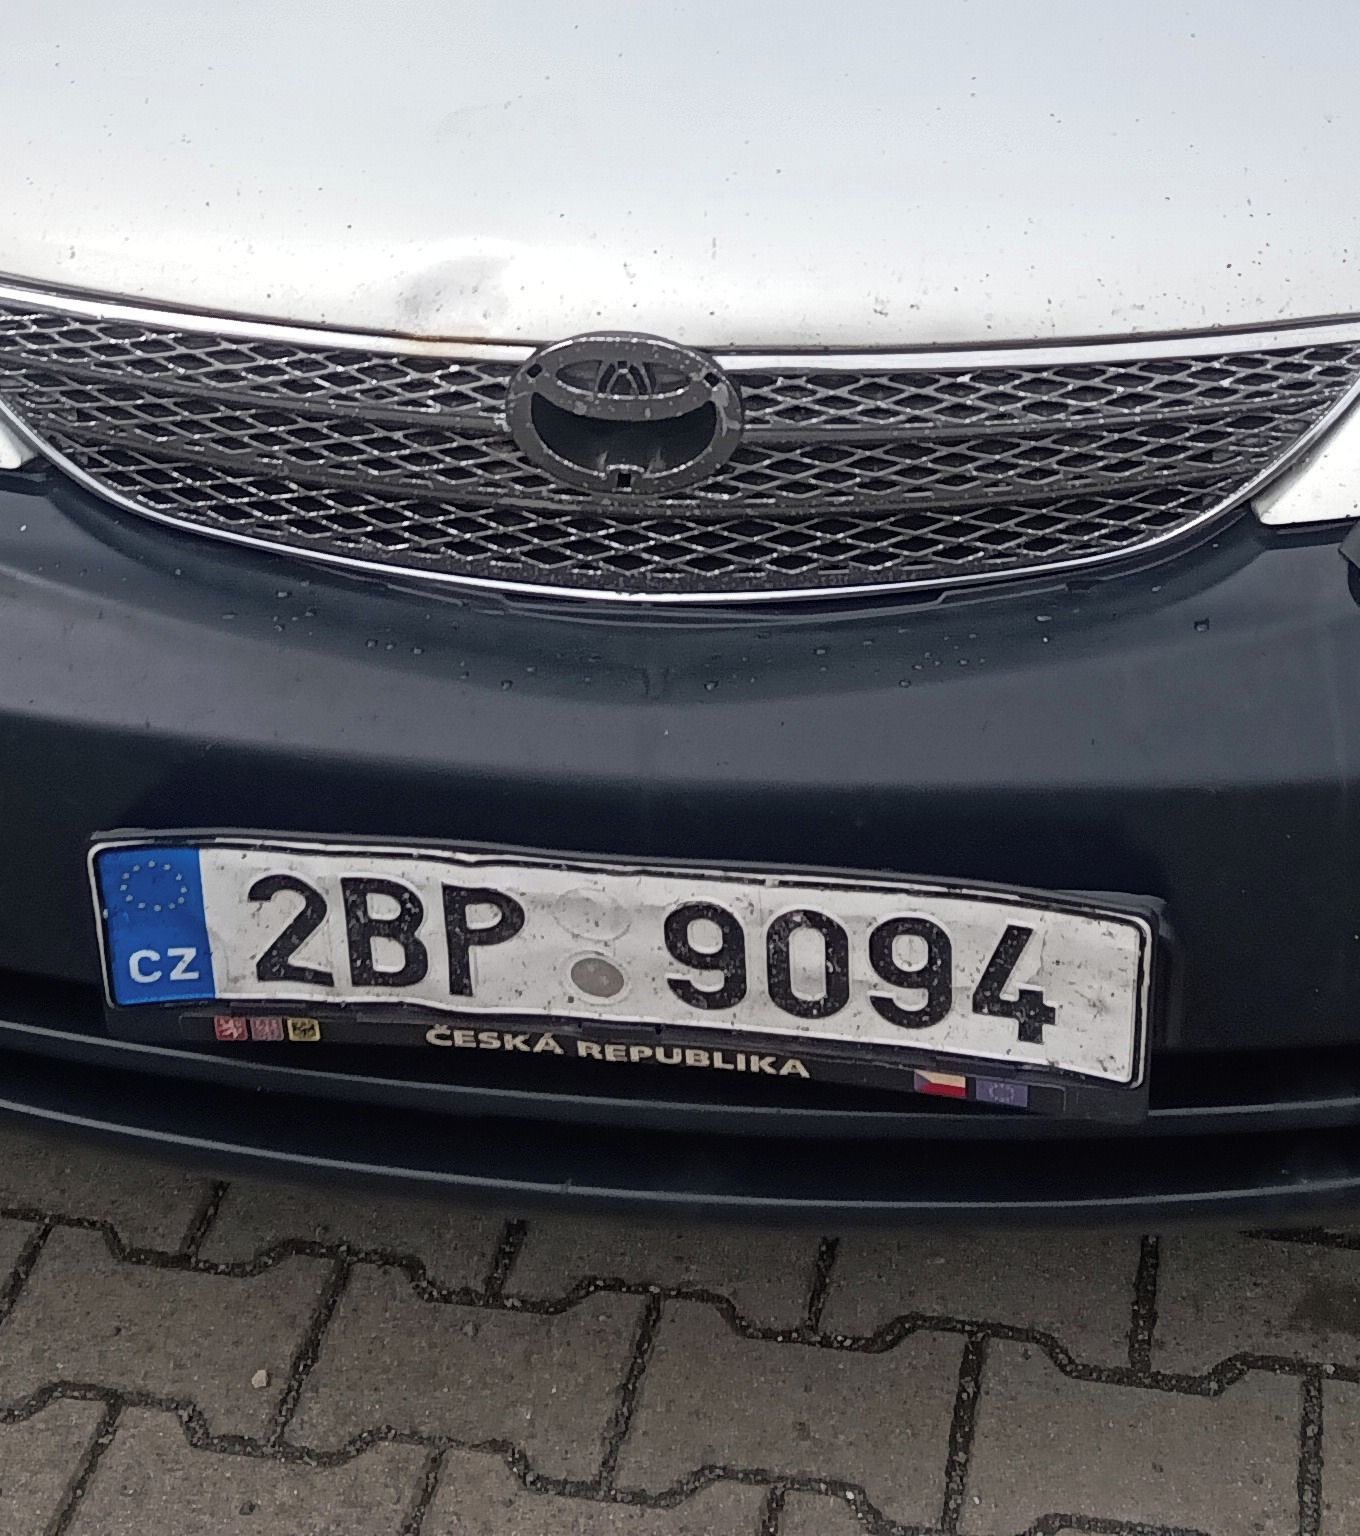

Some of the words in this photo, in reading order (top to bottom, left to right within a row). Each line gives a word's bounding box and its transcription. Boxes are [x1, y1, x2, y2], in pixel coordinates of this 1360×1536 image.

[129, 947, 200, 984] CZ
[247, 873, 526, 997] 2BP
[663, 900, 1056, 1044] 9094
[425, 1024, 564, 1055] ČESKÁ
[576, 1040, 811, 1079] REPUBLIKA
